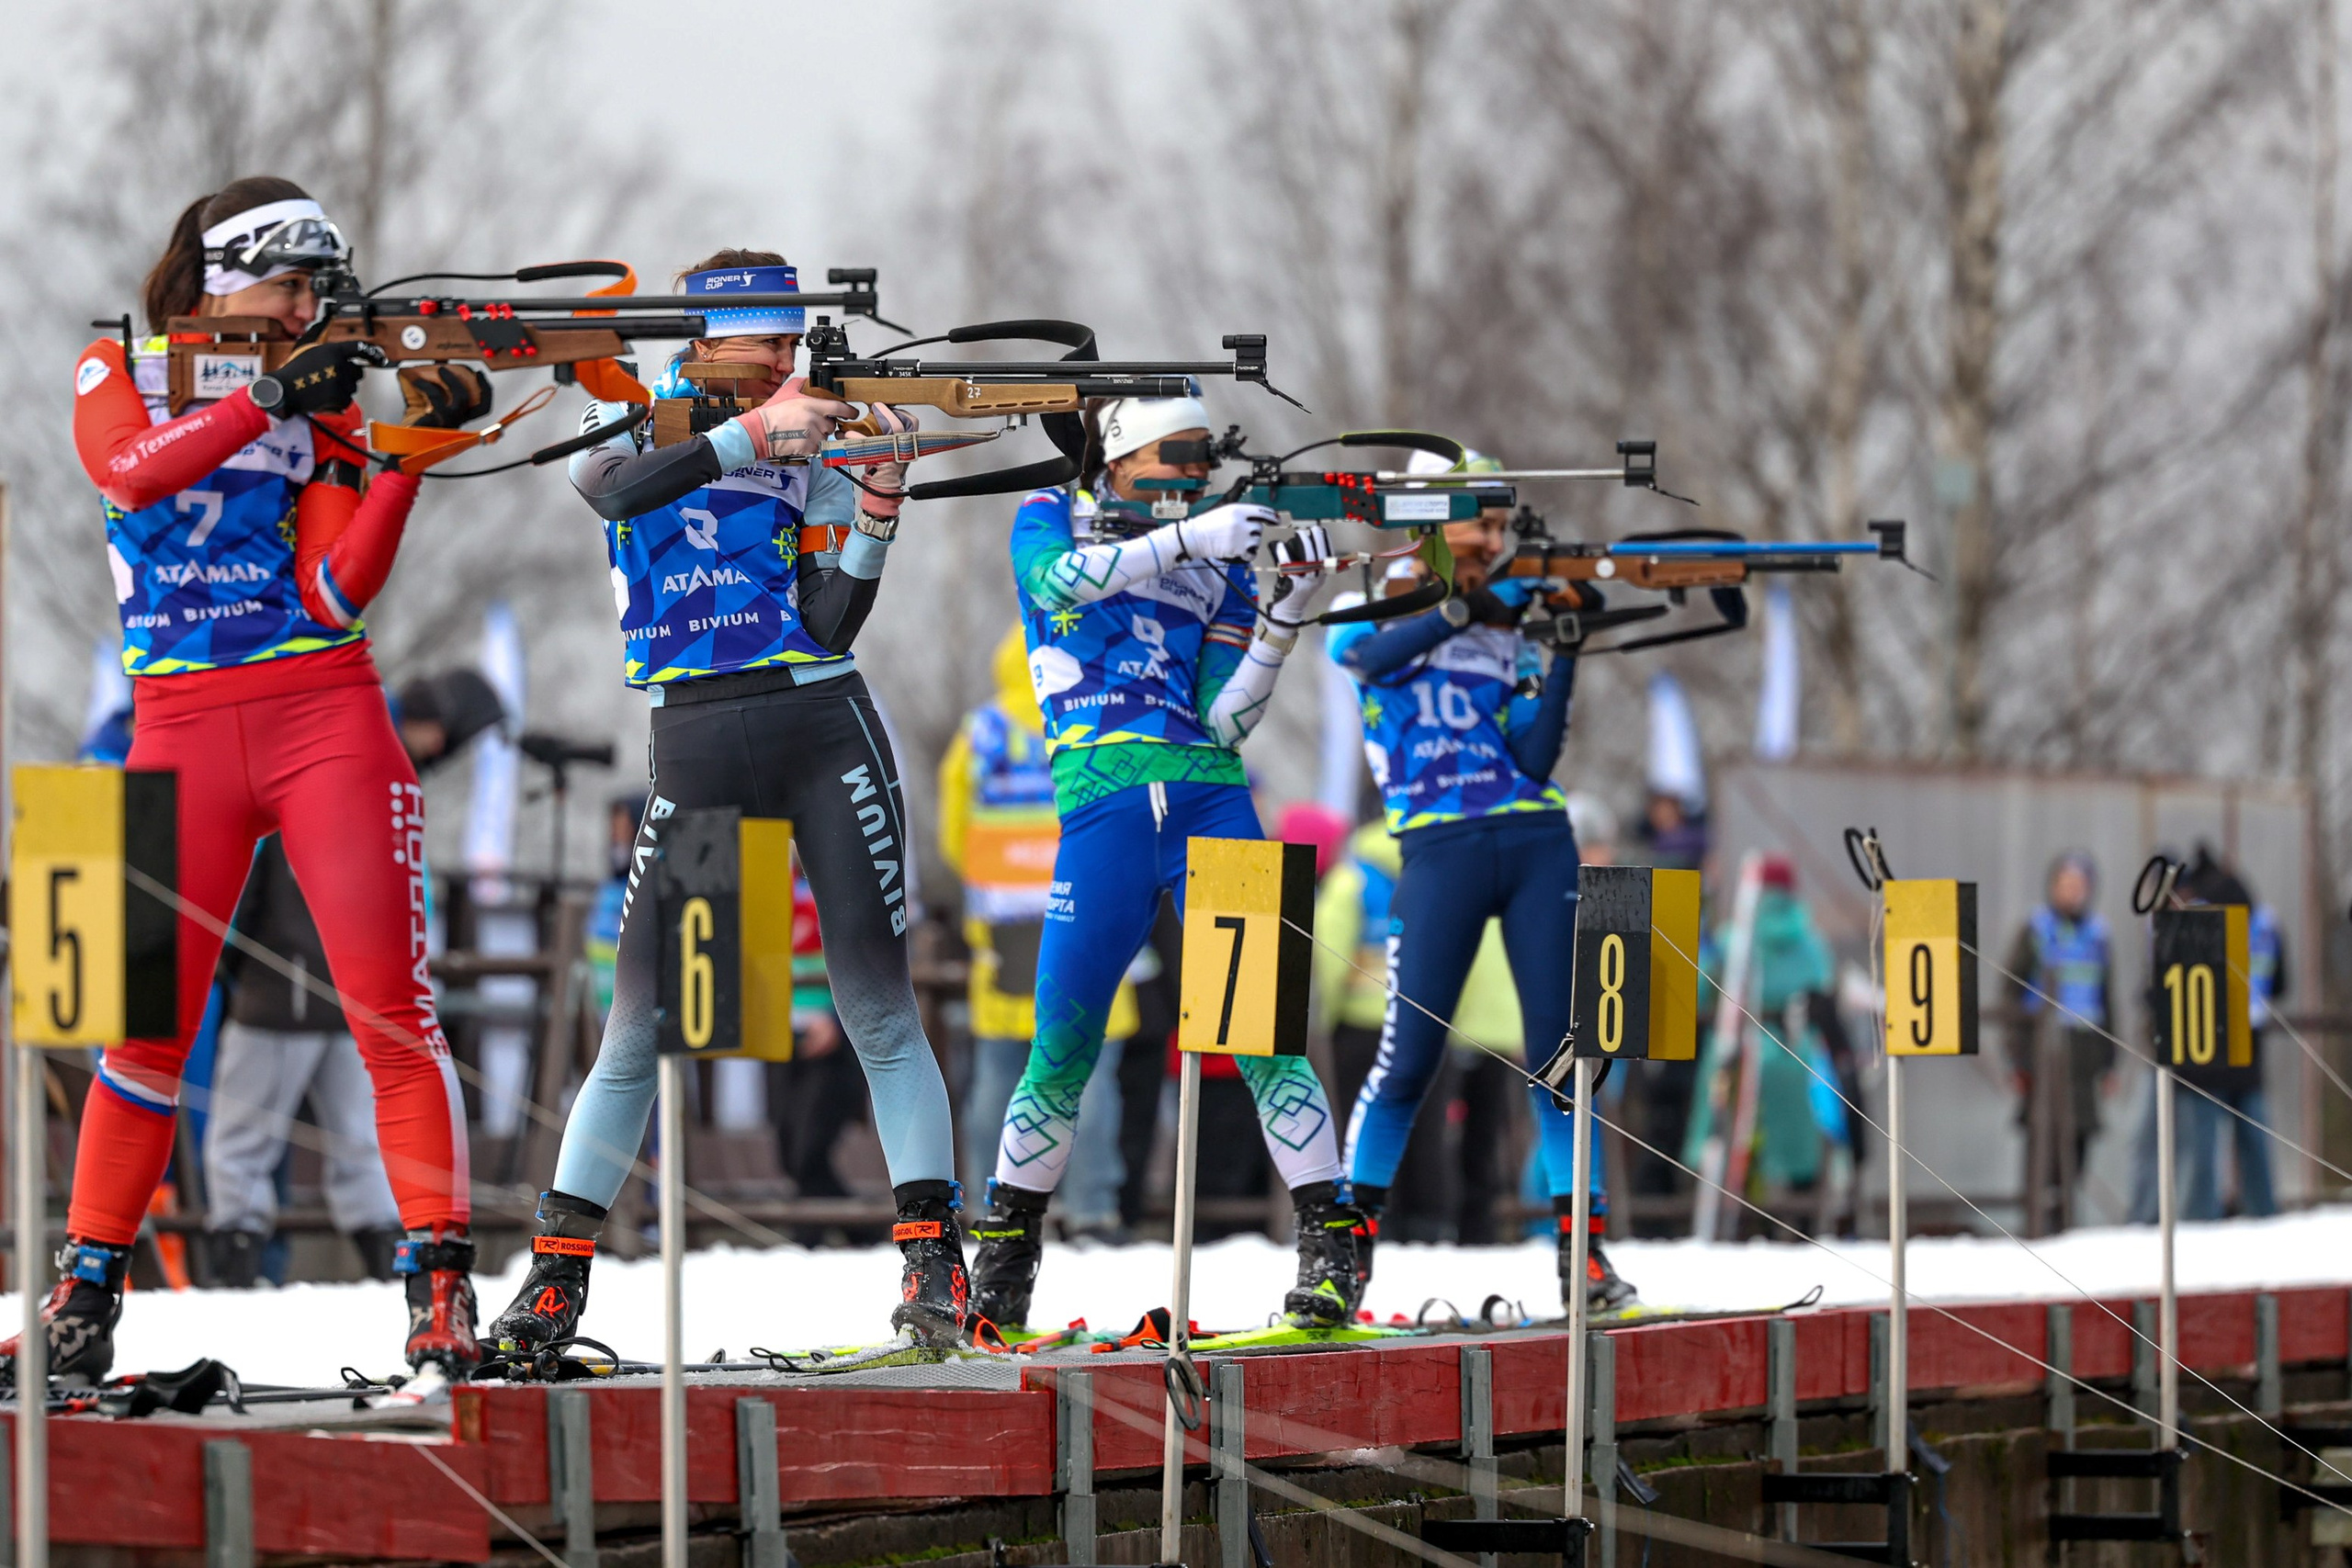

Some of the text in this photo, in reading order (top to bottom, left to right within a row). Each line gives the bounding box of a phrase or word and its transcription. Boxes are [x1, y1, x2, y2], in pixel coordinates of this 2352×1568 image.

[705, 282, 723, 290] CUP
[706, 275, 741, 284] PIONER
[967, 387, 981, 399] 27
[175, 490, 224, 547] 7
[183, 599, 263, 623] BIVIUM
[688, 612, 760, 632] BIVIUM
[1132, 613, 1170, 662] 9
[1063, 693, 1125, 712] BIVIUM
[1410, 680, 1482, 730] 10
[840, 762, 908, 938] BIVIUM
[49, 866, 83, 1031] 5
[680, 896, 715, 1049] 6
[1214, 916, 1247, 1046] 7
[1597, 932, 1625, 1054] 8
[1909, 942, 1934, 1047] 9
[2163, 963, 2216, 1066] 10
